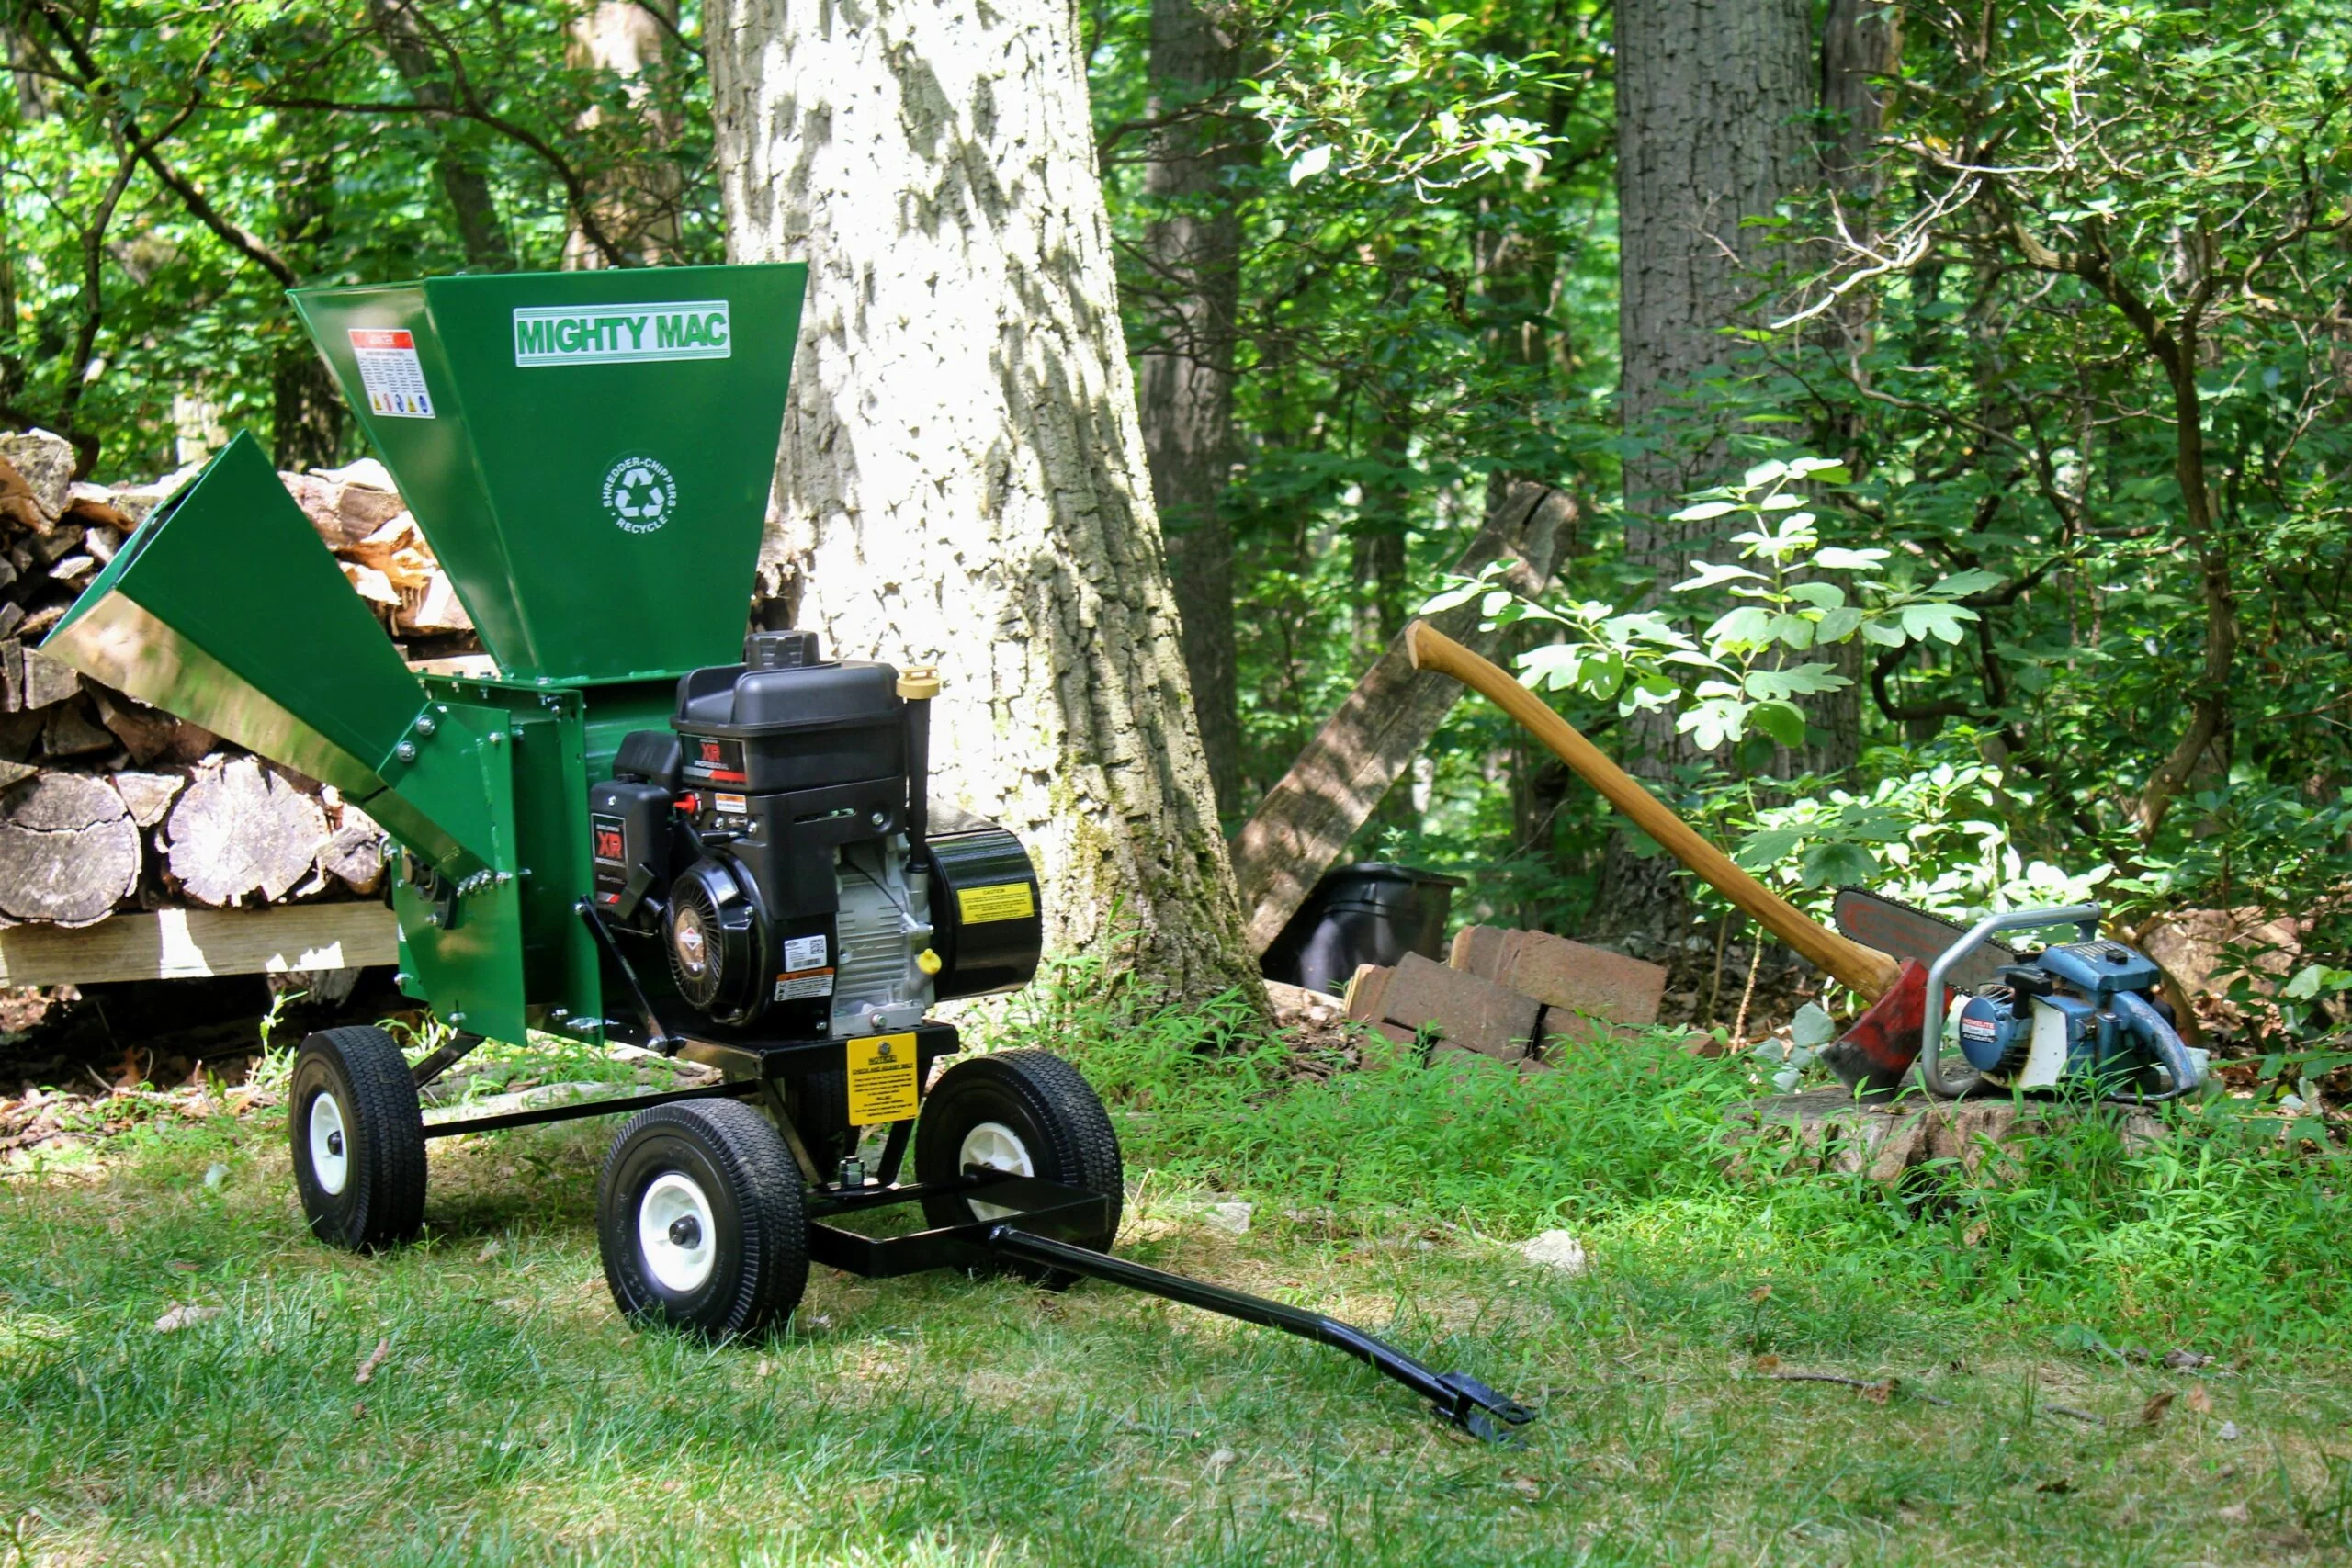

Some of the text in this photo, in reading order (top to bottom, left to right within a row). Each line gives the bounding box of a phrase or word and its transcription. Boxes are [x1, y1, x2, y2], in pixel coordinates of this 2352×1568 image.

[517, 312, 728, 355] MIGHTY MAC
[602, 457, 677, 508] SHREDDER-CHIPPERS
[616, 514, 669, 534] RECYCLE
[701, 742, 721, 761] XR
[596, 830, 623, 859] XR
